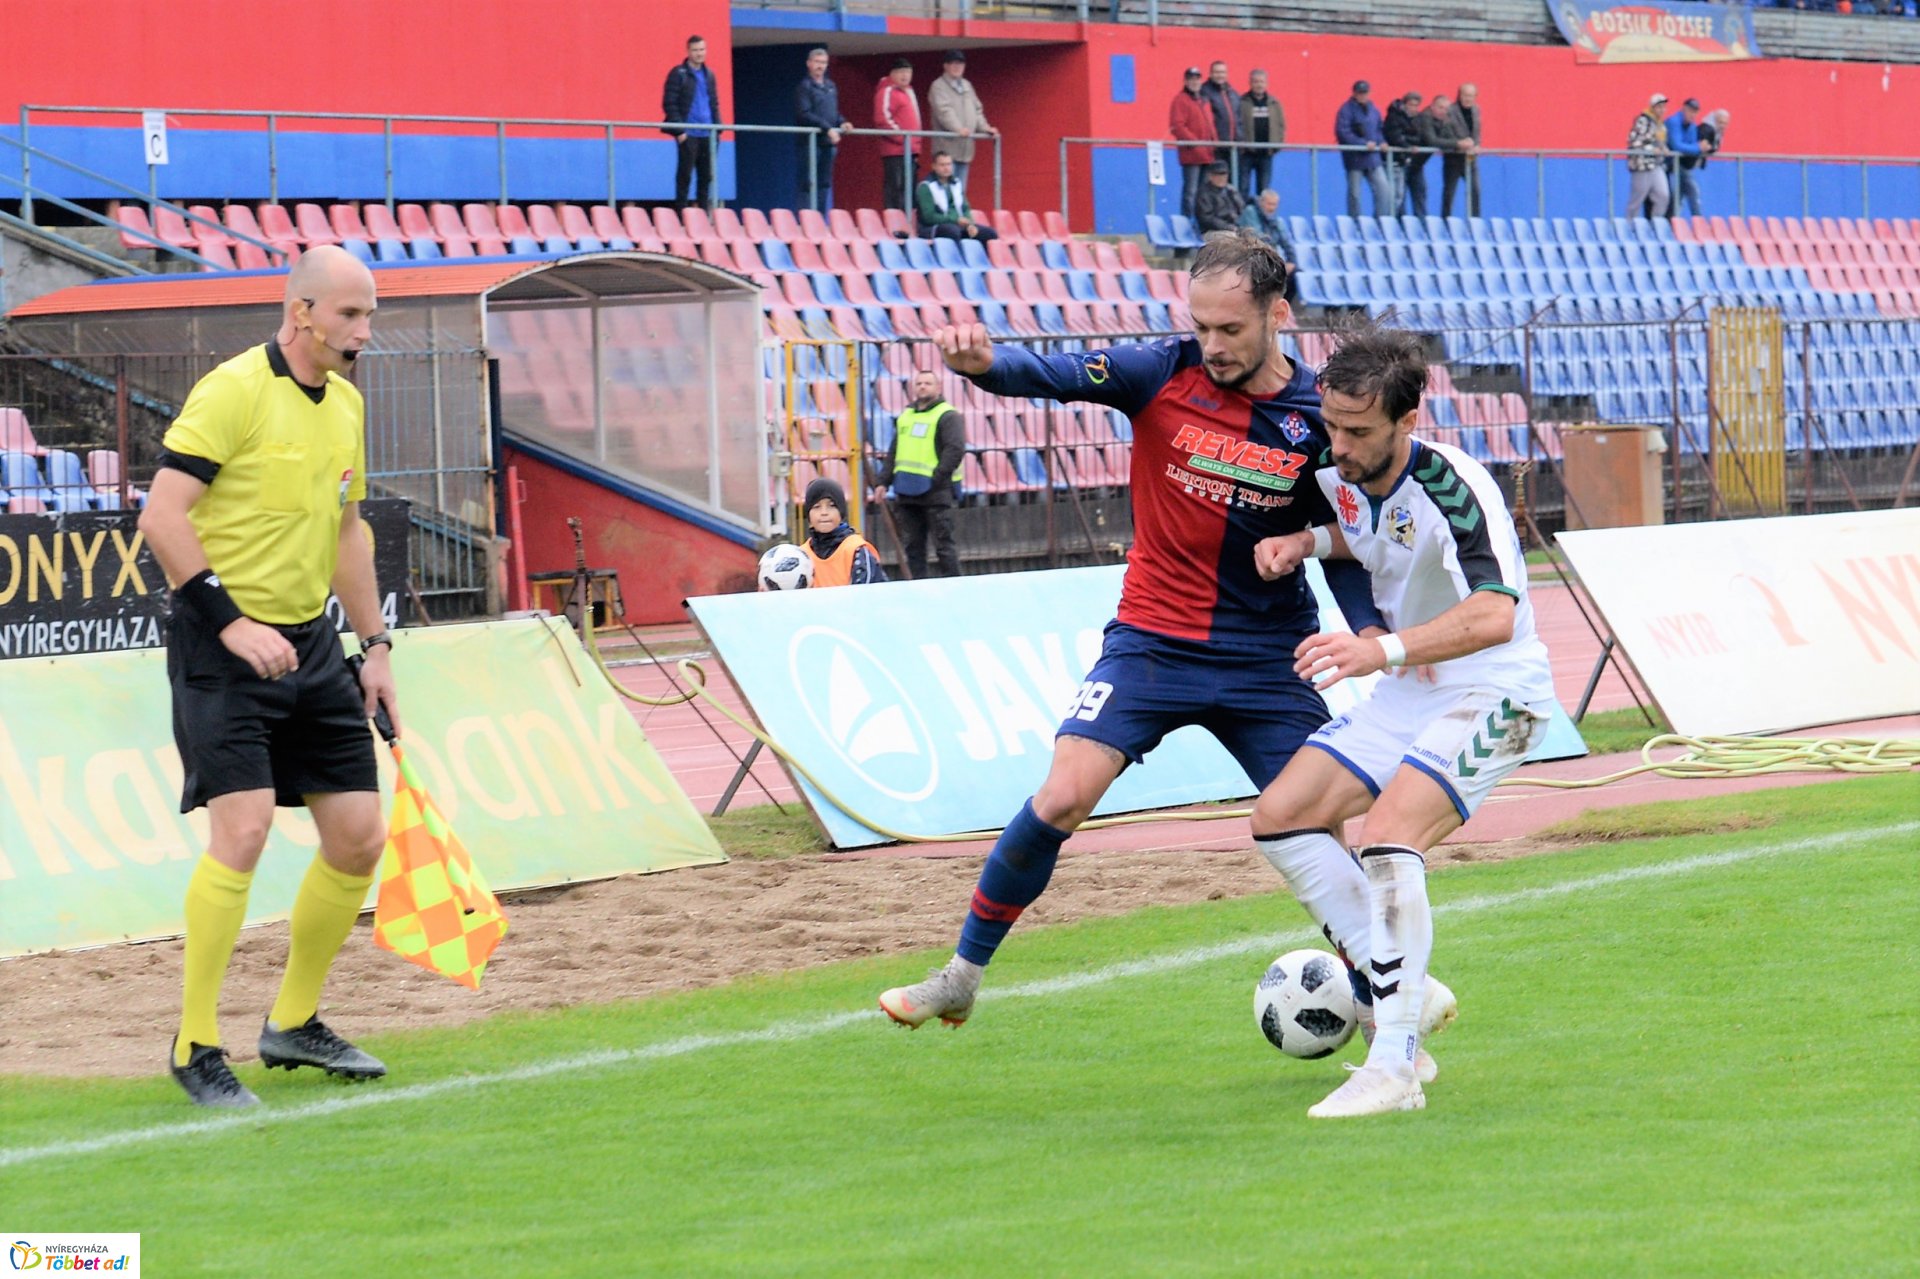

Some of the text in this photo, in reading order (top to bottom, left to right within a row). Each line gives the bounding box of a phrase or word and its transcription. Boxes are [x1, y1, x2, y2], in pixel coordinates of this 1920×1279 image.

[1590, 8, 1713, 38] BOZSIK JÓZSEF
[150, 133, 162, 158] C
[1165, 463, 1237, 497] LERTON
[1191, 458, 1290, 489] ALWAYS ON THE RIGHT WAY
